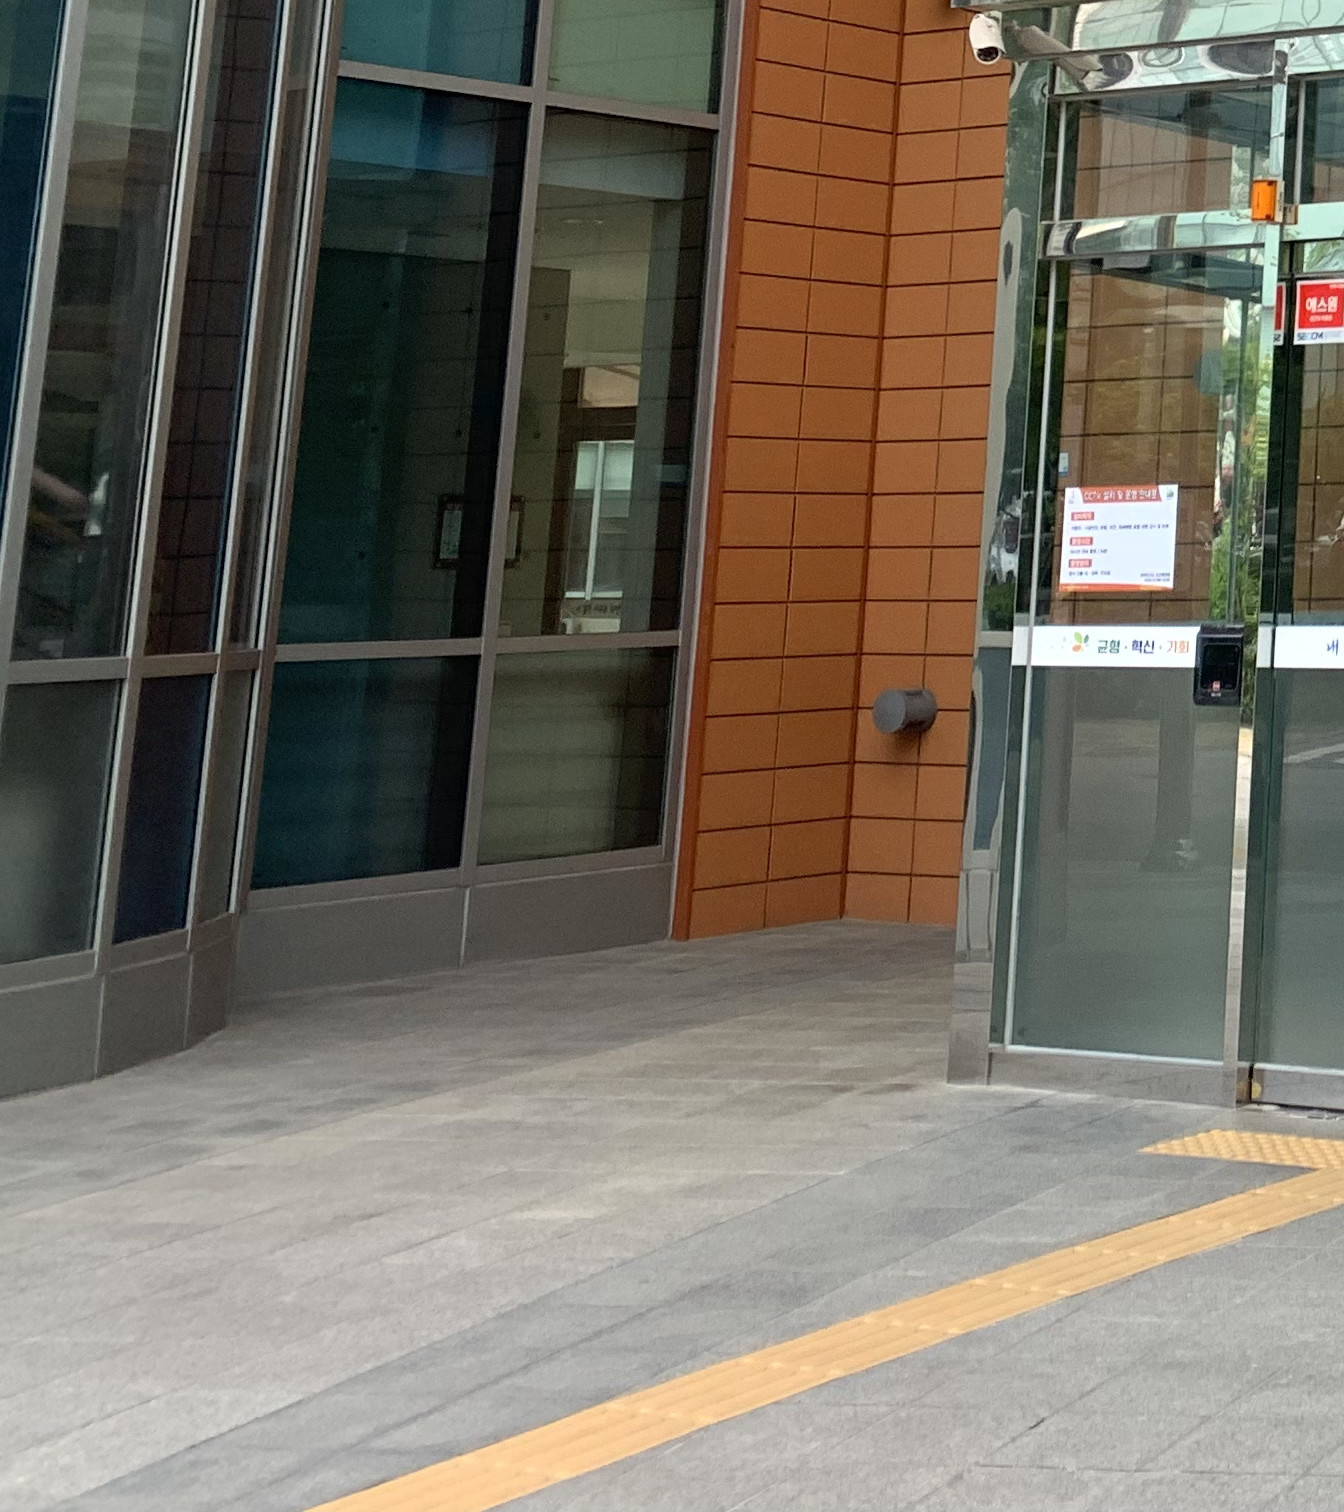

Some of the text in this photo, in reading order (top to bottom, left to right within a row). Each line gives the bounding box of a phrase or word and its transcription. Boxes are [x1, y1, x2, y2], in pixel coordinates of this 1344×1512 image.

[1097, 639, 1190, 654] 균형 혁신 기회
[1326, 638, 1339, 657] 내
